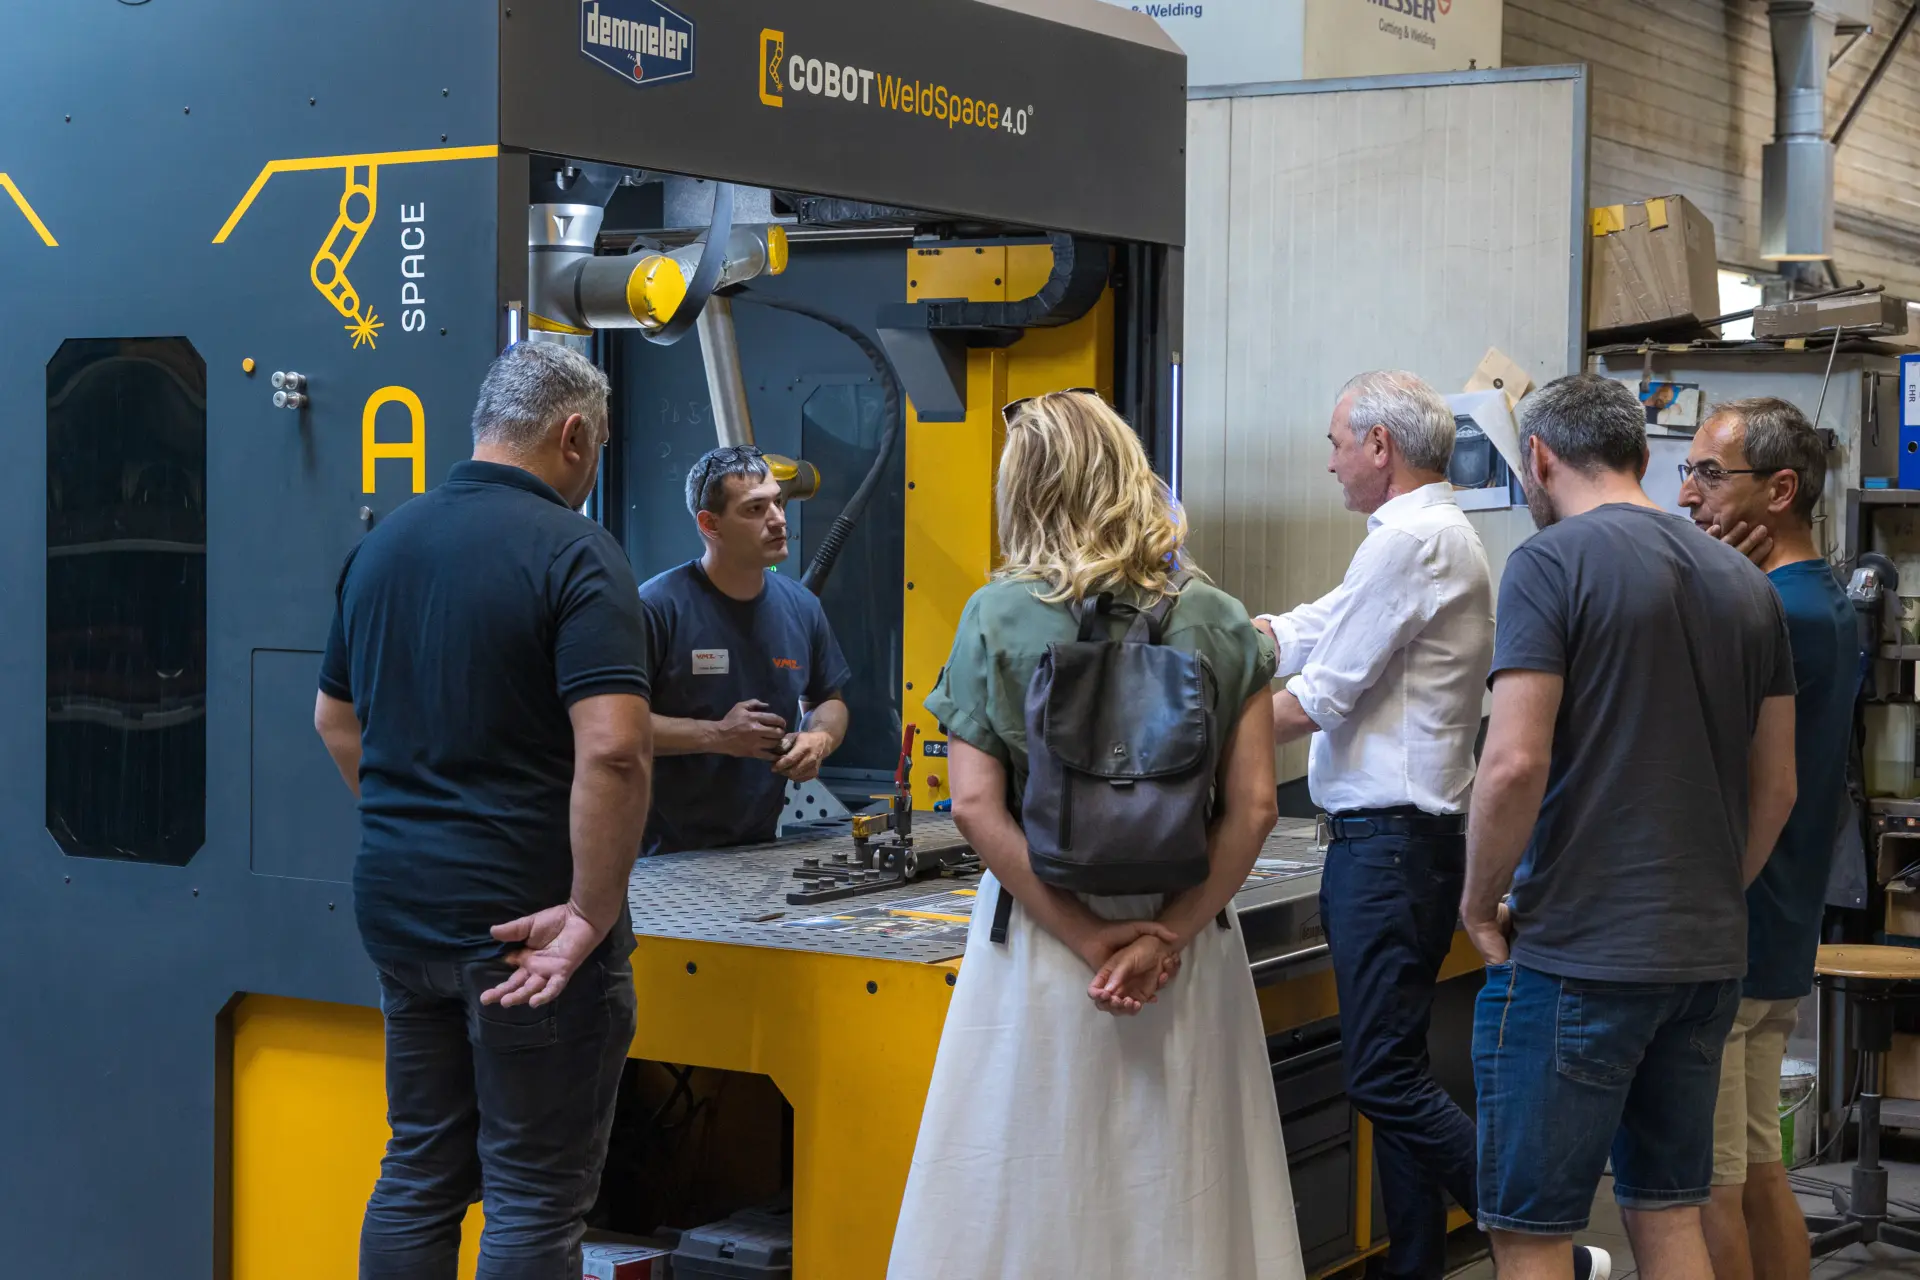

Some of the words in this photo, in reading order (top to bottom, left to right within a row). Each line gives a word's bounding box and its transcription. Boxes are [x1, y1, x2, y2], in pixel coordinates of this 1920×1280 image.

[587, 2, 688, 61] demmeler
[1146, 3, 1203, 18] Welding
[789, 54, 874, 105] COBOT
[877, 73, 999, 129] WeldSpace
[401, 201, 426, 332] SPACE
[1908, 384, 1917, 403] EHR
[362, 385, 425, 494] A
